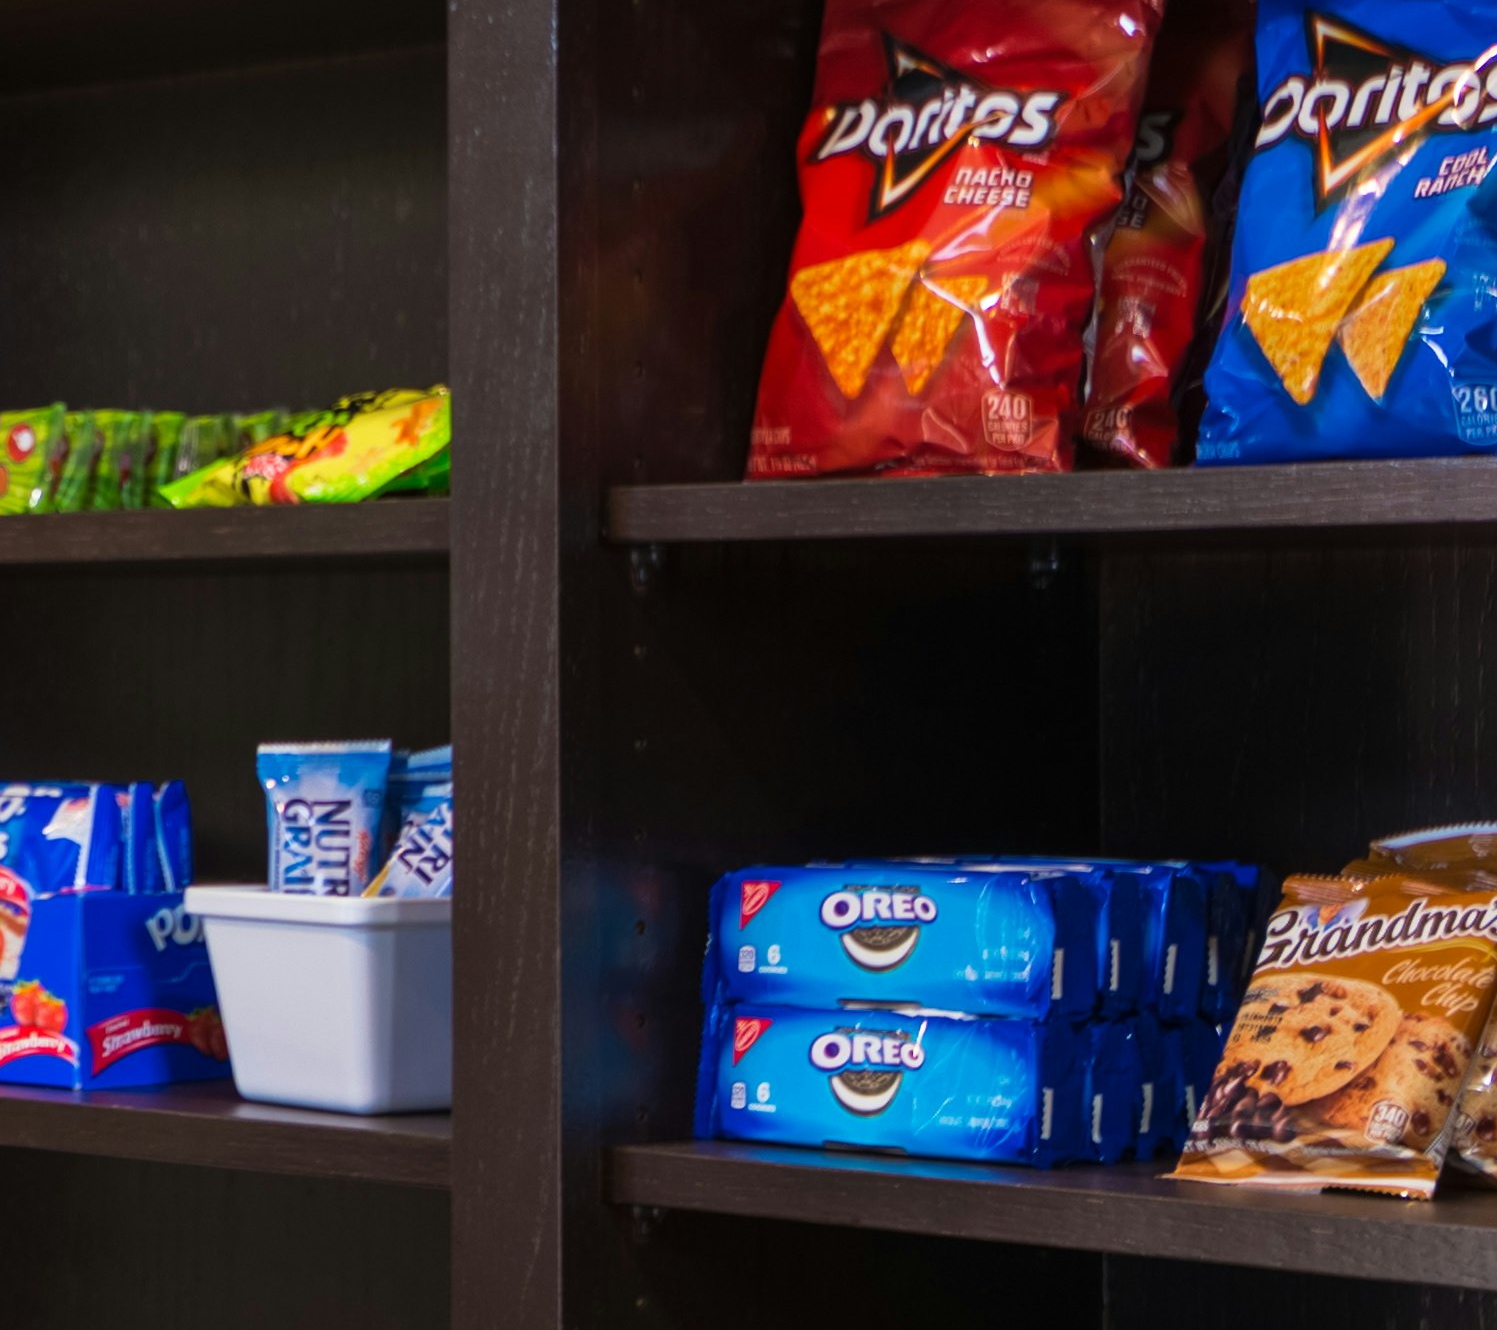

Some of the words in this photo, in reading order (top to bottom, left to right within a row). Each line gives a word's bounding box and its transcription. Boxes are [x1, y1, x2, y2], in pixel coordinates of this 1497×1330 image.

[818, 86, 1061, 159] Doritos
[1439, 148, 1489, 176] COOL
[955, 167, 1032, 189] NACHO
[1414, 166, 1488, 199] RANCH
[943, 186, 1031, 209] CHEESE
[987, 395, 1026, 422] 240
[821, 892, 937, 928] OREO
[766, 944, 781, 964] 6
[1381, 959, 1496, 988] Chocolate
[1420, 983, 1479, 1014] Chip
[100, 1021, 183, 1058] Strawberry
[810, 1032, 926, 1070] OREO
[1373, 1106, 1406, 1125] 340
